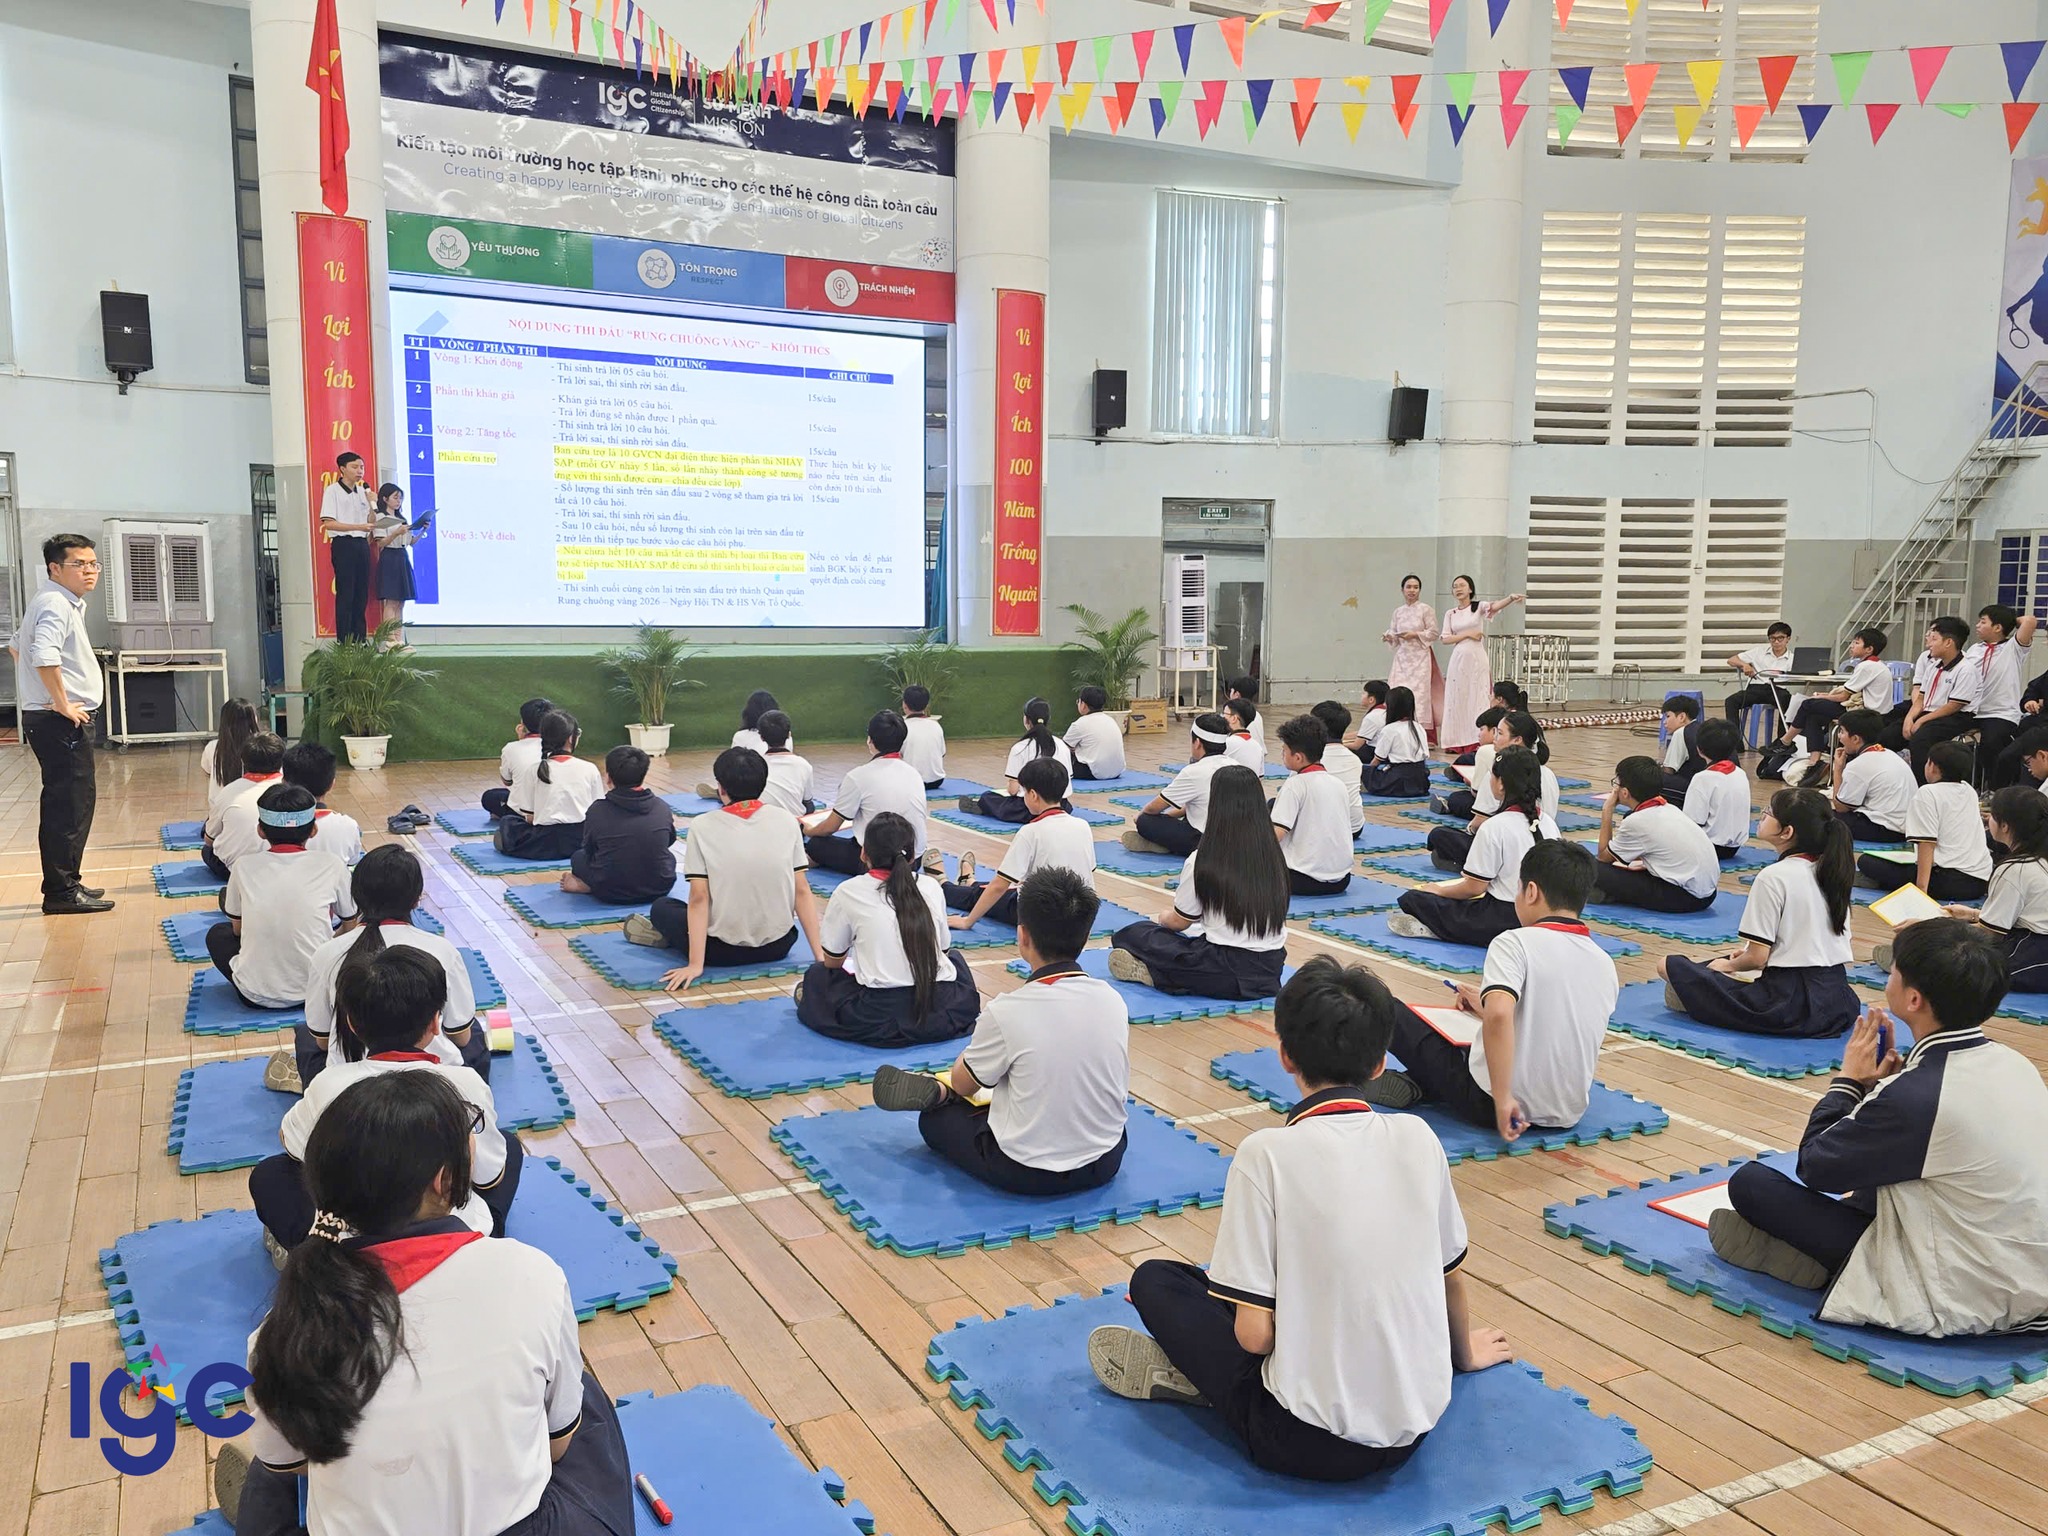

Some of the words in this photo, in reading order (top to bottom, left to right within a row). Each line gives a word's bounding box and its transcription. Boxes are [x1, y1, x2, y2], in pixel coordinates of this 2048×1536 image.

[651, 98, 671, 107] Global
[650, 106, 686, 117] Citizenship
[704, 114, 765, 137] MISSION
[397, 134, 434, 151] Kiến
[440, 140, 467, 158] tạo
[472, 144, 503, 161] môi
[567, 156, 595, 175] học
[600, 162, 625, 180] tập
[671, 172, 707, 188] phúc
[711, 177, 737, 191] cho
[742, 180, 765, 195] các
[770, 182, 794, 198] thế
[796, 187, 813, 200] hệ
[817, 191, 850, 207] công
[854, 194, 878, 209] dân
[882, 198, 911, 212] toàn
[915, 199, 938, 216] cầu
[444, 162, 504, 182] Creating
[509, 174, 516, 182] a
[522, 172, 564, 191] happy
[568, 178, 621, 198] learning
[807, 209, 819, 219] of
[822, 211, 857, 224] global
[862, 216, 904, 230] citizens
[471, 240, 492, 252] YÊU
[495, 244, 540, 257] THƯƠNG
[324, 260, 346, 284] Vì
[679, 262, 700, 273] TÔN
[703, 266, 737, 278] TRỌNG
[859, 282, 888, 293] TRÁCH
[889, 285, 915, 296] NHIỆM
[323, 313, 352, 341] Lợi
[508, 319, 531, 332] NỘI
[536, 322, 570, 333] DUNG
[576, 326, 595, 336] THI
[802, 345, 830, 356] THCS
[1015, 328, 1031, 346] Vì
[409, 338, 425, 346] TT
[439, 339, 474, 350] VÒNG
[518, 346, 538, 356] THI
[677, 359, 706, 370] DUNG
[830, 372, 848, 381] GHI
[850, 373, 870, 383] CHÚ
[414, 352, 420, 360] 1
[434, 352, 460, 364] Vòng
[464, 355, 472, 364] 1:
[475, 356, 497, 366] Khởi
[500, 358, 523, 370] động
[324, 360, 355, 390] Ích
[557, 362, 572, 372] Thí
[575, 364, 593, 374] sinh
[610, 366, 621, 376] lời
[623, 367, 634, 377] 05
[636, 369, 650, 378] câu
[416, 384, 422, 393] 2
[558, 375, 572, 385] Trả
[575, 376, 587, 386] lời
[589, 378, 604, 388] sai,
[606, 379, 618, 388] thí
[620, 380, 638, 390] sinh
[1012, 372, 1032, 394] Lợi
[462, 388, 473, 396] thi
[558, 394, 582, 405] Khán
[614, 398, 625, 408] lời
[628, 399, 638, 409] 05
[640, 401, 655, 410] câu
[559, 407, 573, 417] Trả
[576, 408, 587, 418] lời
[590, 409, 611, 422] đúng
[625, 412, 645, 424] nhận
[648, 413, 669, 425] được
[672, 414, 675, 423] 1
[1011, 410, 1033, 434] Ích
[416, 424, 423, 432] 3
[437, 426, 462, 437] Vòng
[466, 428, 474, 436] 2:
[476, 428, 500, 439] Tăng
[503, 428, 516, 438] tốc
[559, 420, 574, 430] Thí
[576, 421, 594, 431] sinh
[611, 423, 622, 432] lời
[625, 424, 635, 433] 10
[637, 425, 652, 434] câu
[418, 452, 424, 460] 4
[484, 456, 496, 464] trợ
[1009, 458, 1033, 476] 100
[1004, 500, 1036, 519] Năm
[441, 530, 466, 540] Vòng
[1000, 541, 1037, 564] Trồng
[558, 596, 580, 606] Rung
[640, 597, 660, 606] 2026
[694, 598, 709, 607] Hội
[727, 598, 735, 606] &
[998, 584, 1038, 606] Người
